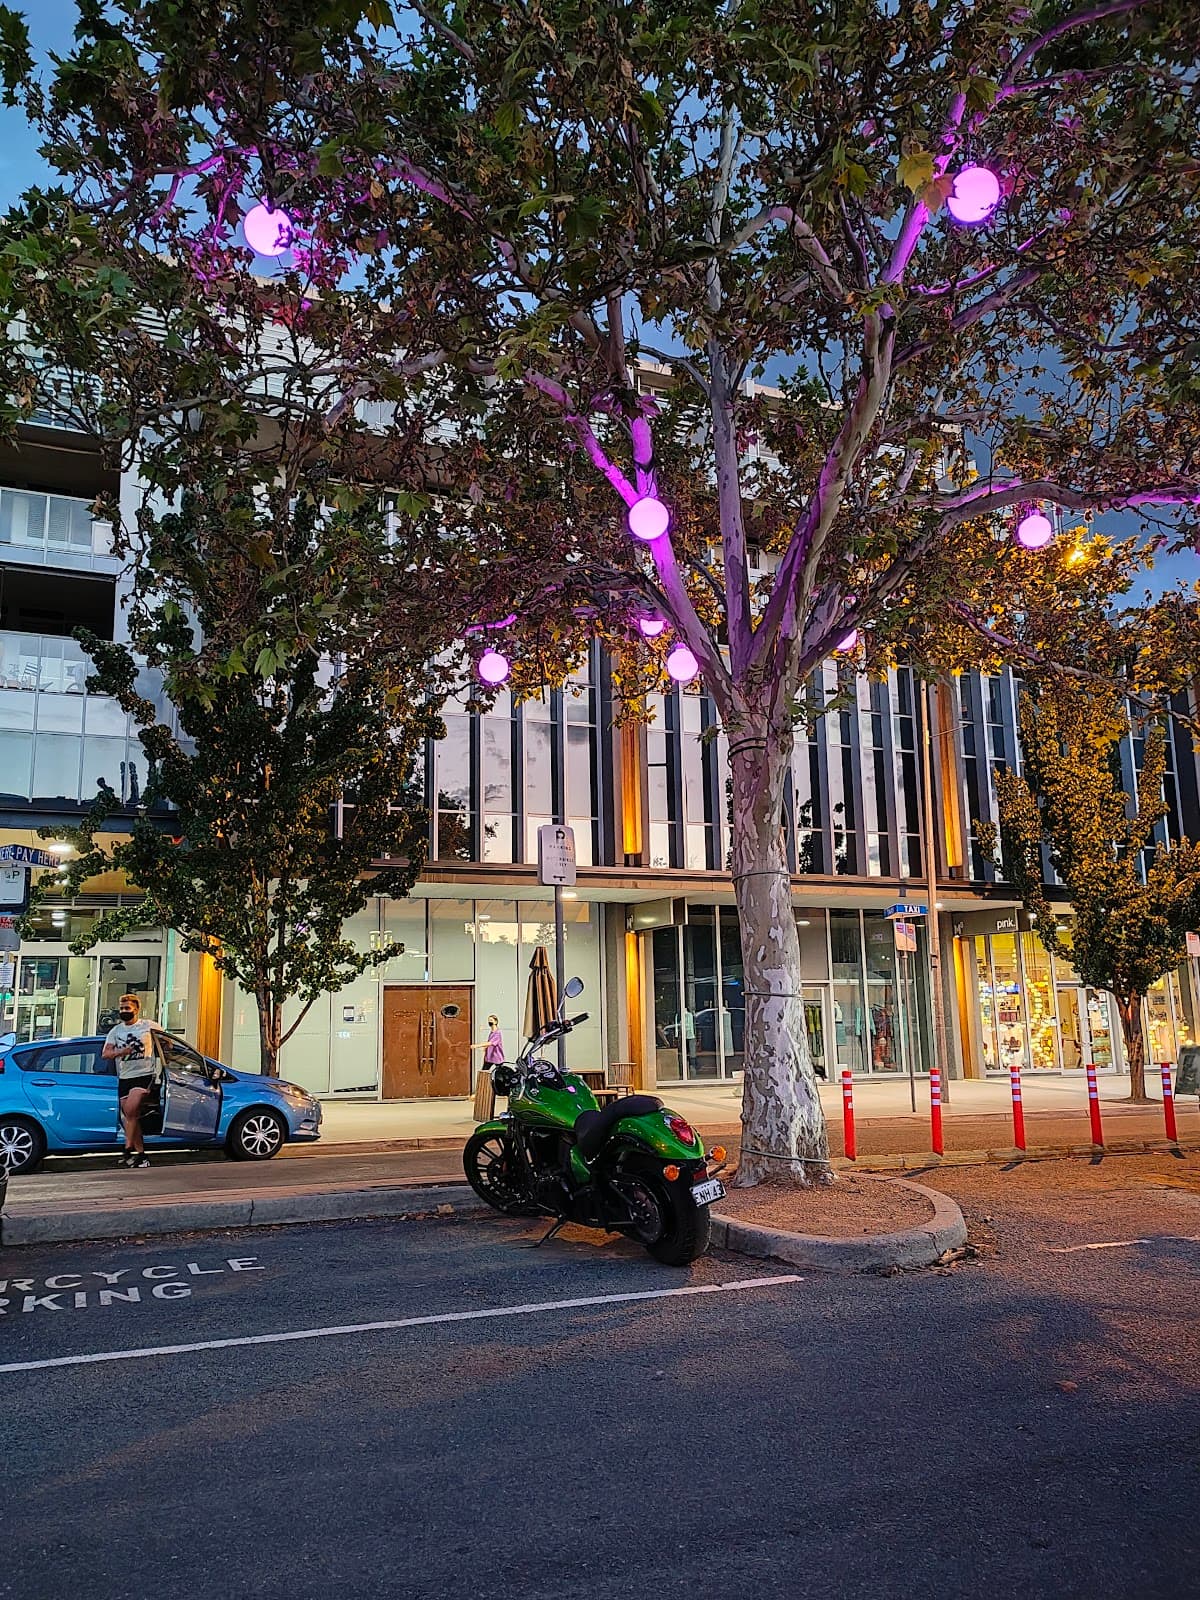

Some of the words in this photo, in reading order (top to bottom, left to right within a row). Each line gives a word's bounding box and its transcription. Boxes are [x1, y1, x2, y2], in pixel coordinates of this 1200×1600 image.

[16, 847, 34, 862] PAY
[38, 851, 60, 867] HERE
[904, 905, 920, 914] TAXI
